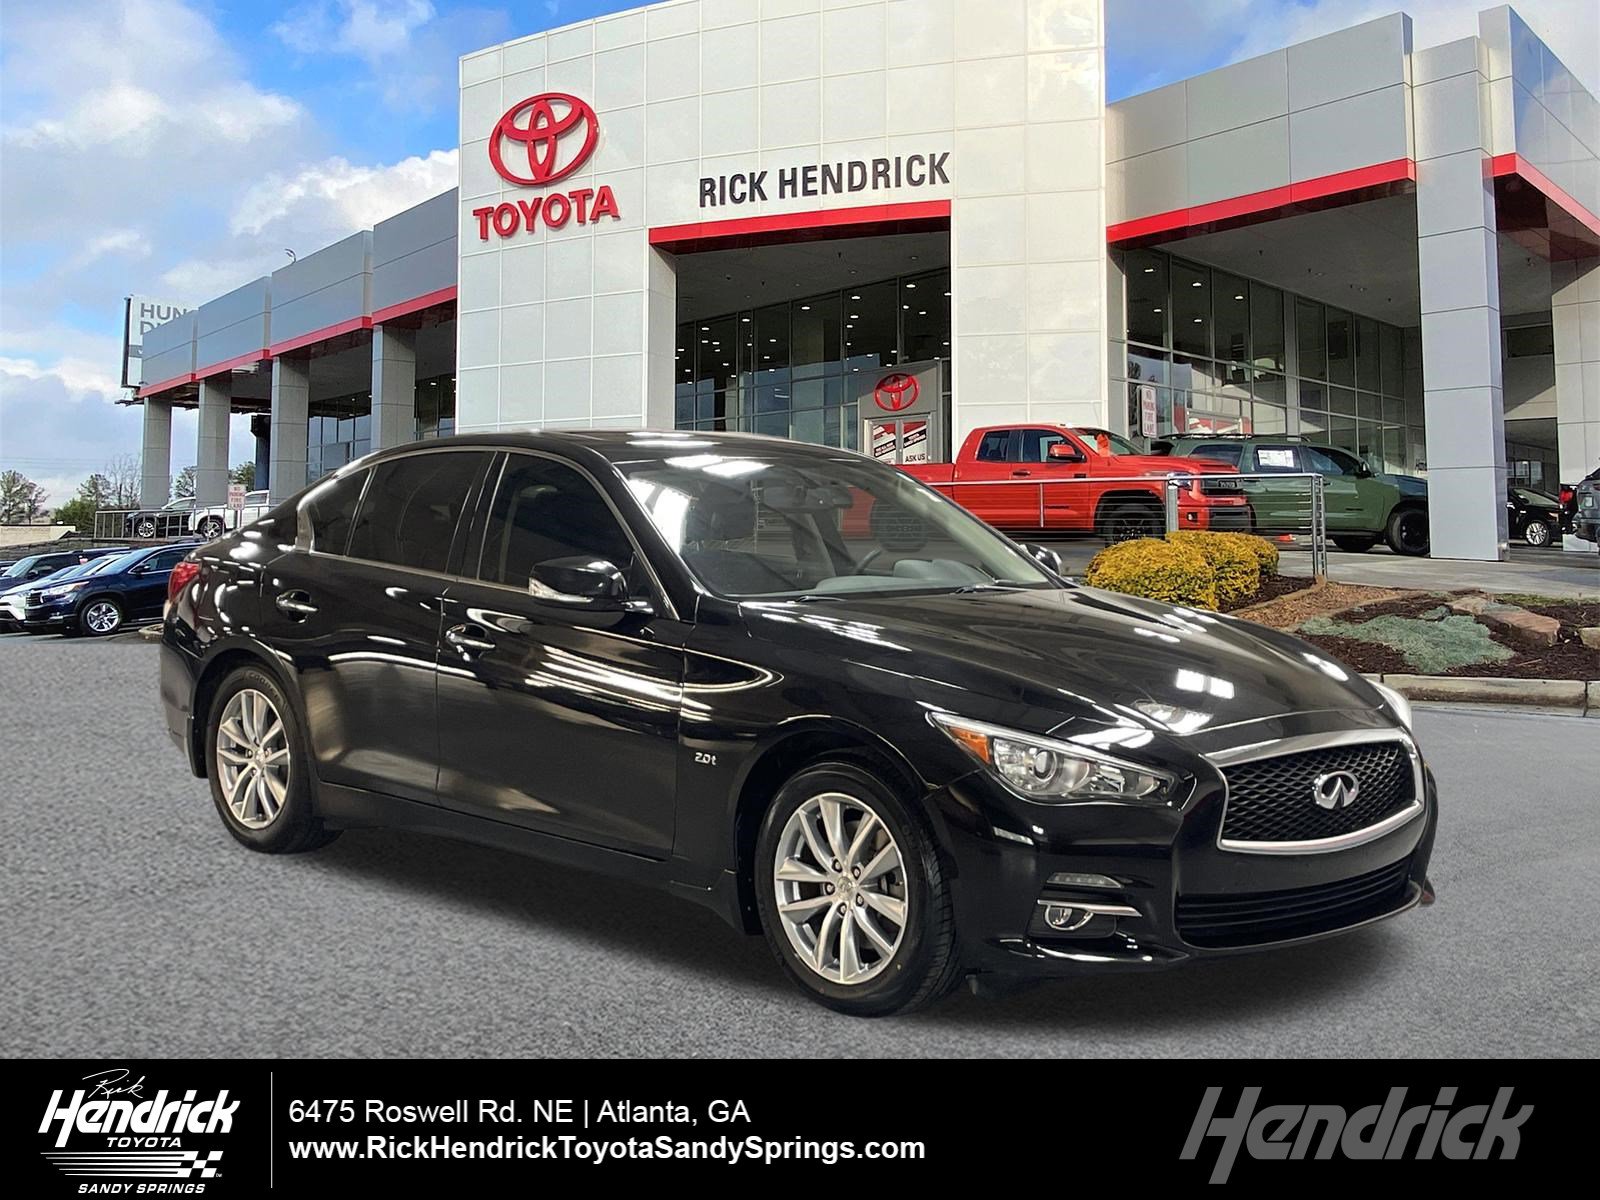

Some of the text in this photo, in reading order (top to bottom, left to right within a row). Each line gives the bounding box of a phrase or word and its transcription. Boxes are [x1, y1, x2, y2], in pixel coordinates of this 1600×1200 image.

[699, 152, 951, 208] RICK HENDRICK
[473, 185, 621, 242] TOYOTA
[905, 455, 917, 463] ASK
[917, 453, 926, 461] US
